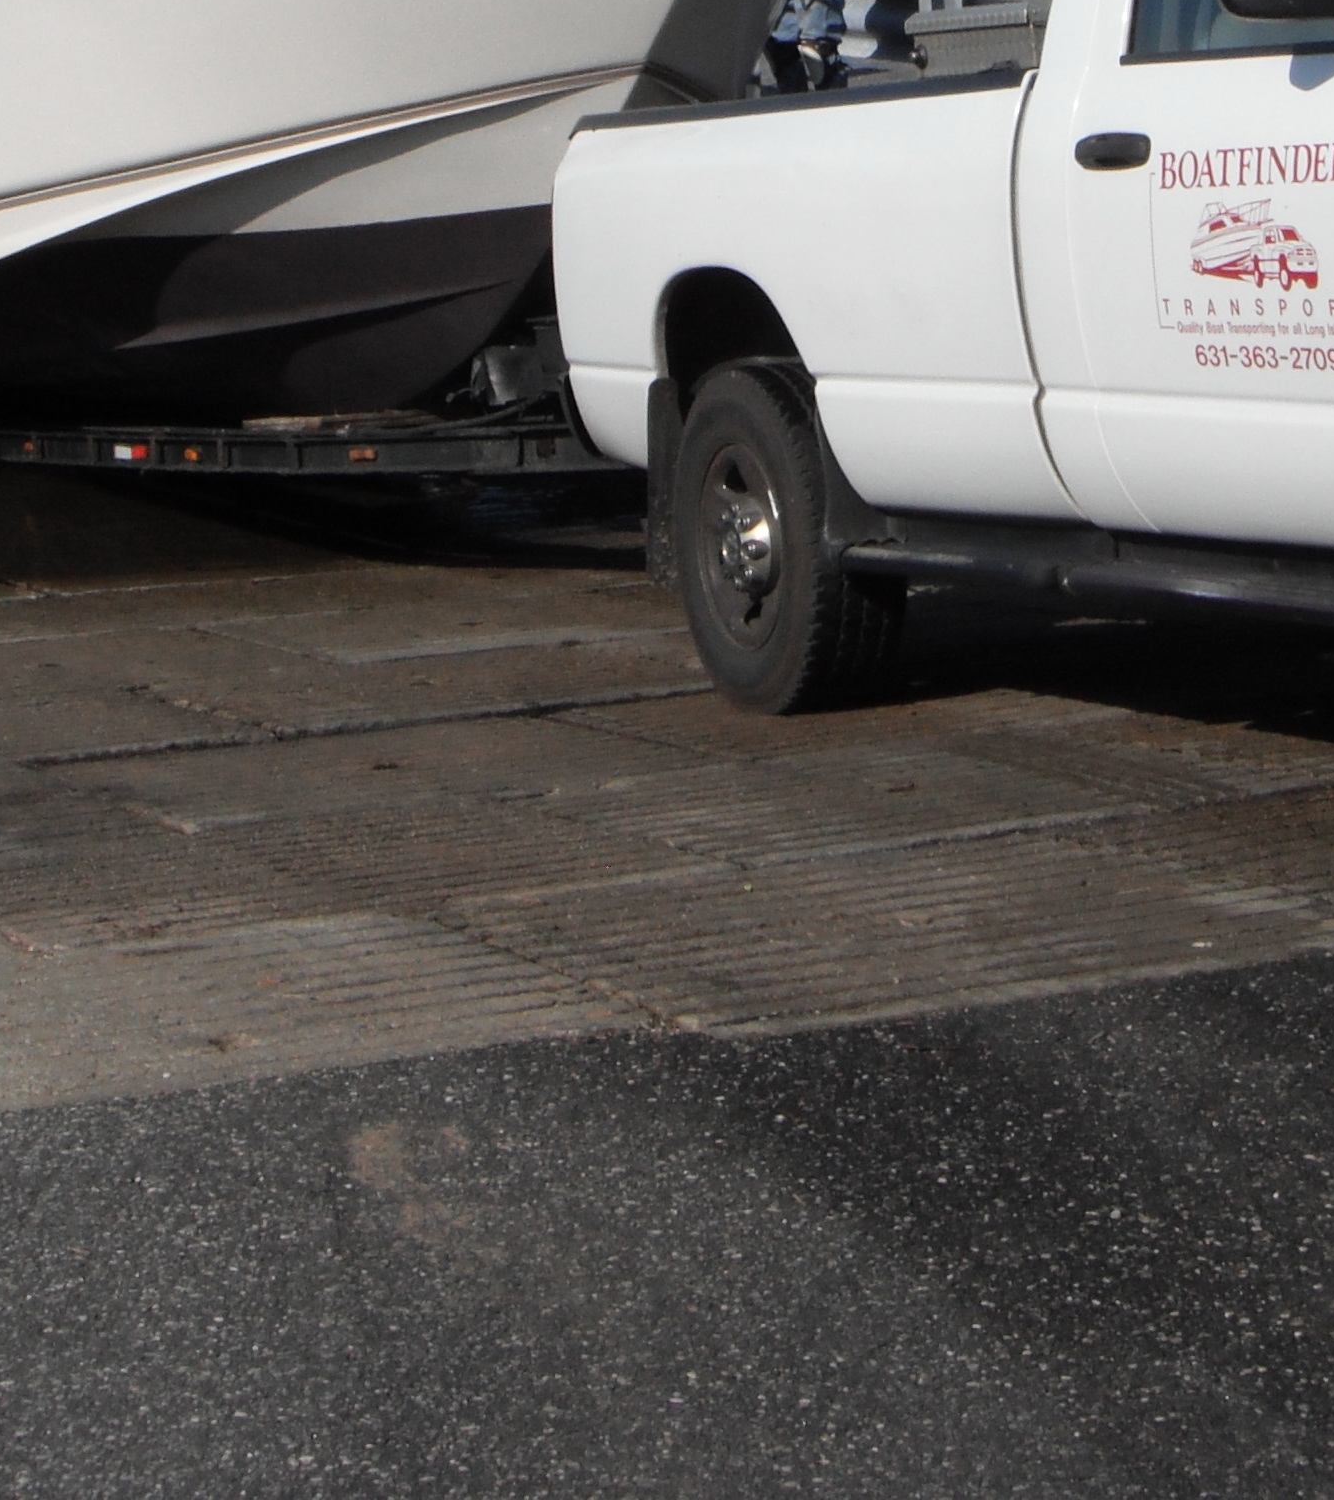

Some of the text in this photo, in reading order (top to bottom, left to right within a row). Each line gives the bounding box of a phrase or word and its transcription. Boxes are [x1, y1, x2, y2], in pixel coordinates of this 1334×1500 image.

[1177, 321, 1204, 336] Quality
[1206, 321, 1225, 334] Boat
[1227, 321, 1276, 337] Transporting
[1278, 322, 1289, 335] for
[1293, 322, 1302, 334] all
[1304, 323, 1326, 338] Long
